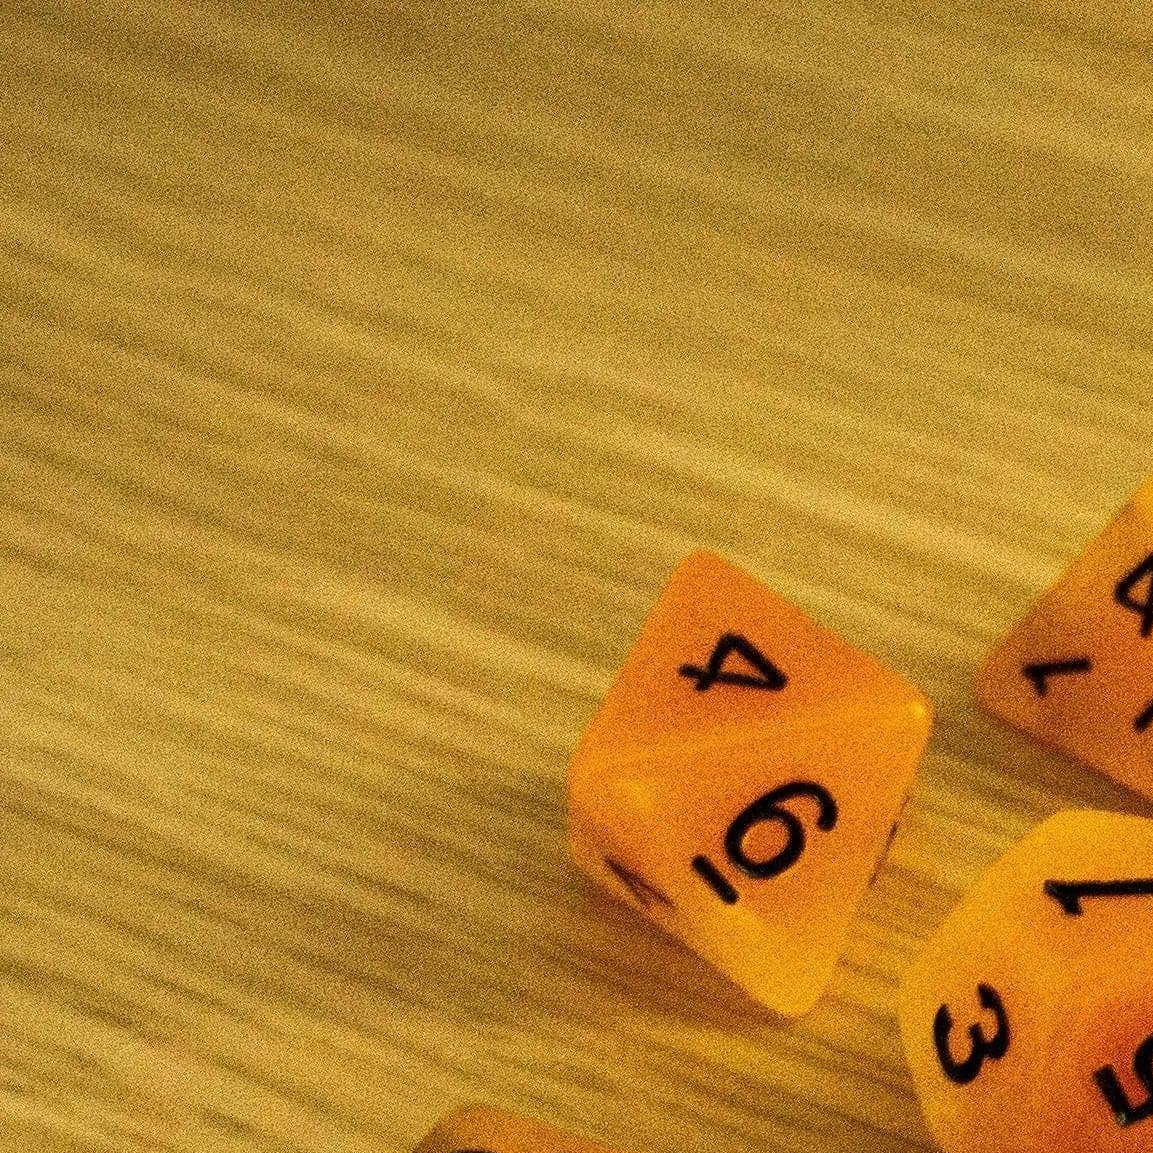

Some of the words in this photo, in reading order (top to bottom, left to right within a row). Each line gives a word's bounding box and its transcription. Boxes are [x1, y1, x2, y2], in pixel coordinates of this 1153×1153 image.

[679, 633, 787, 692] 4
[1022, 657, 1091, 697] 1
[933, 983, 1011, 1086] 3
